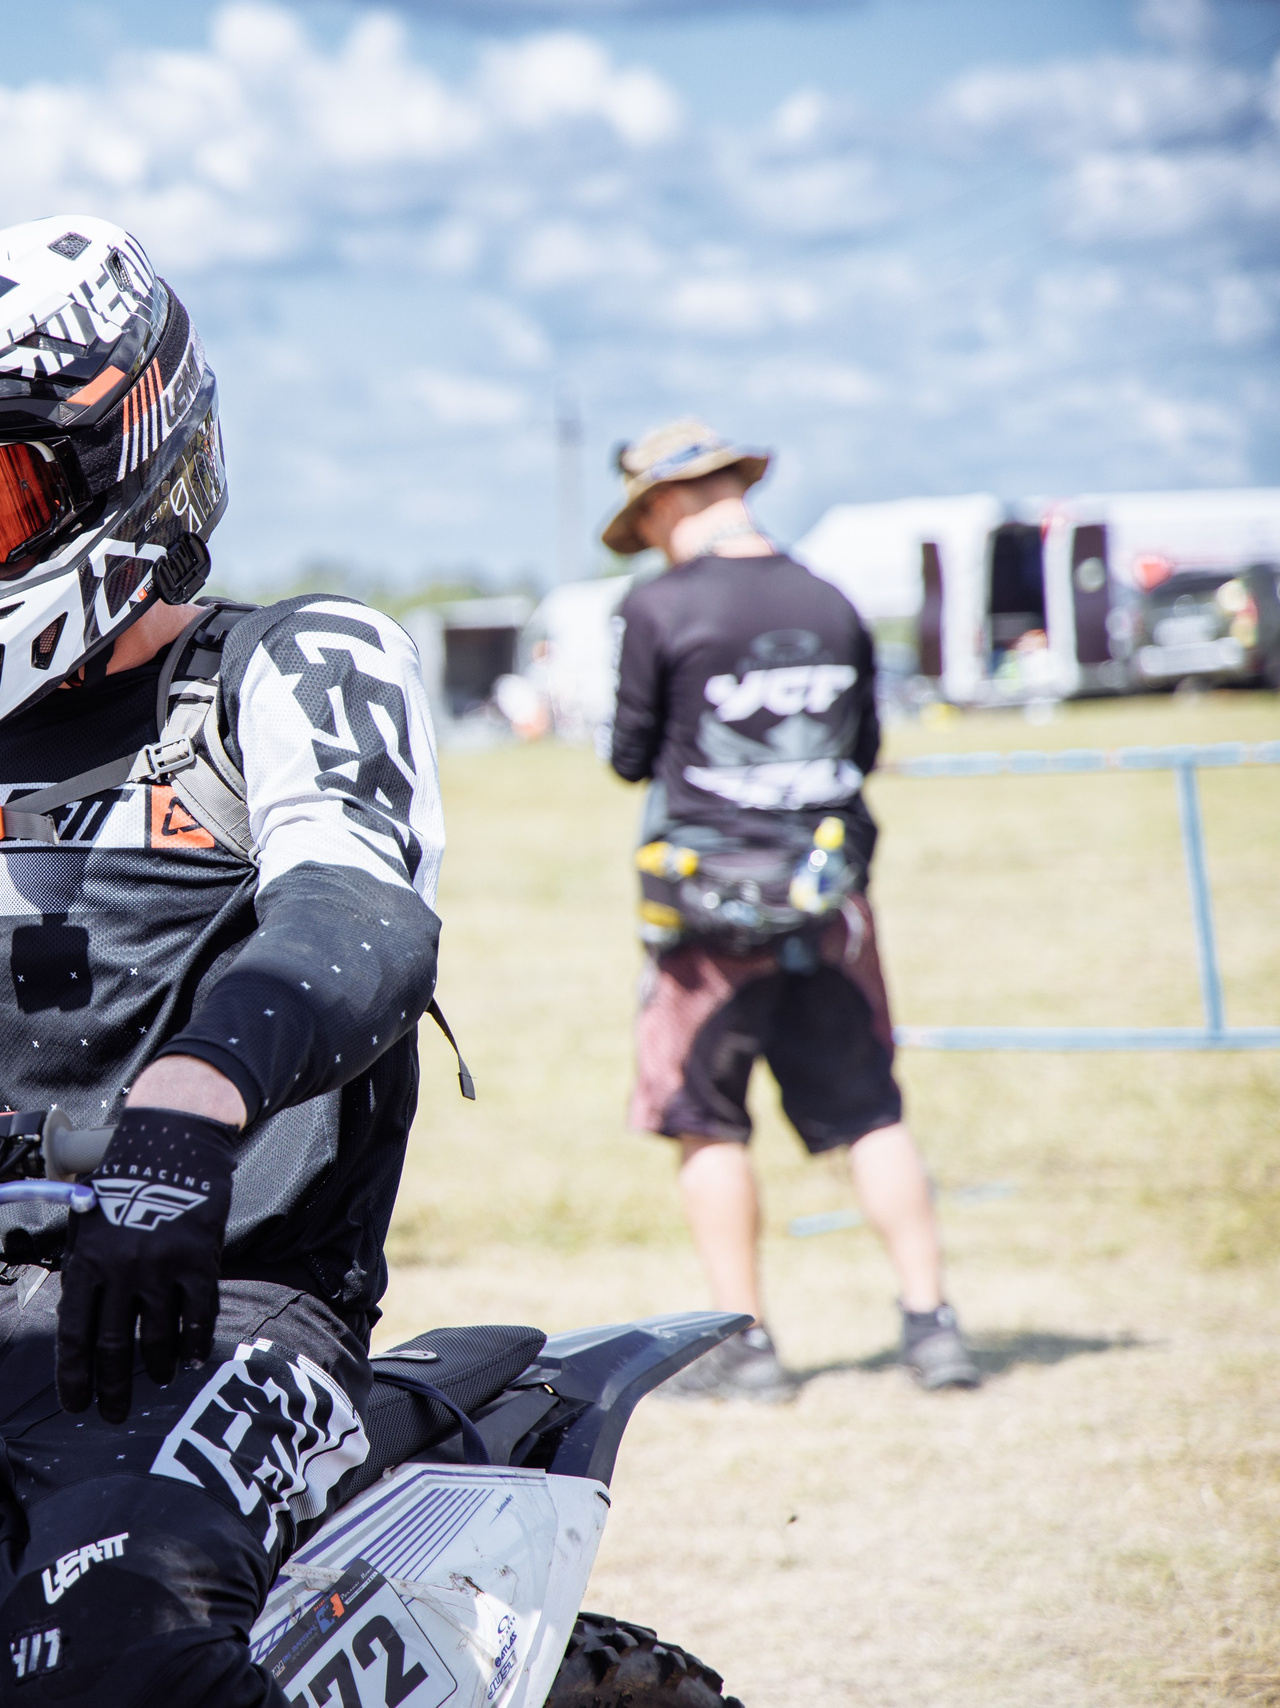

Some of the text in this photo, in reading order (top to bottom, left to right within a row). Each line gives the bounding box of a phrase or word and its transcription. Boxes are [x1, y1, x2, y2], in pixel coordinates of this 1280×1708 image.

[129, 1165, 211, 1191] RACING
[42, 1532, 130, 1605] LEATT
[290, 1615, 428, 1708] 72
[500, 1631, 518, 1662] ATLAS
